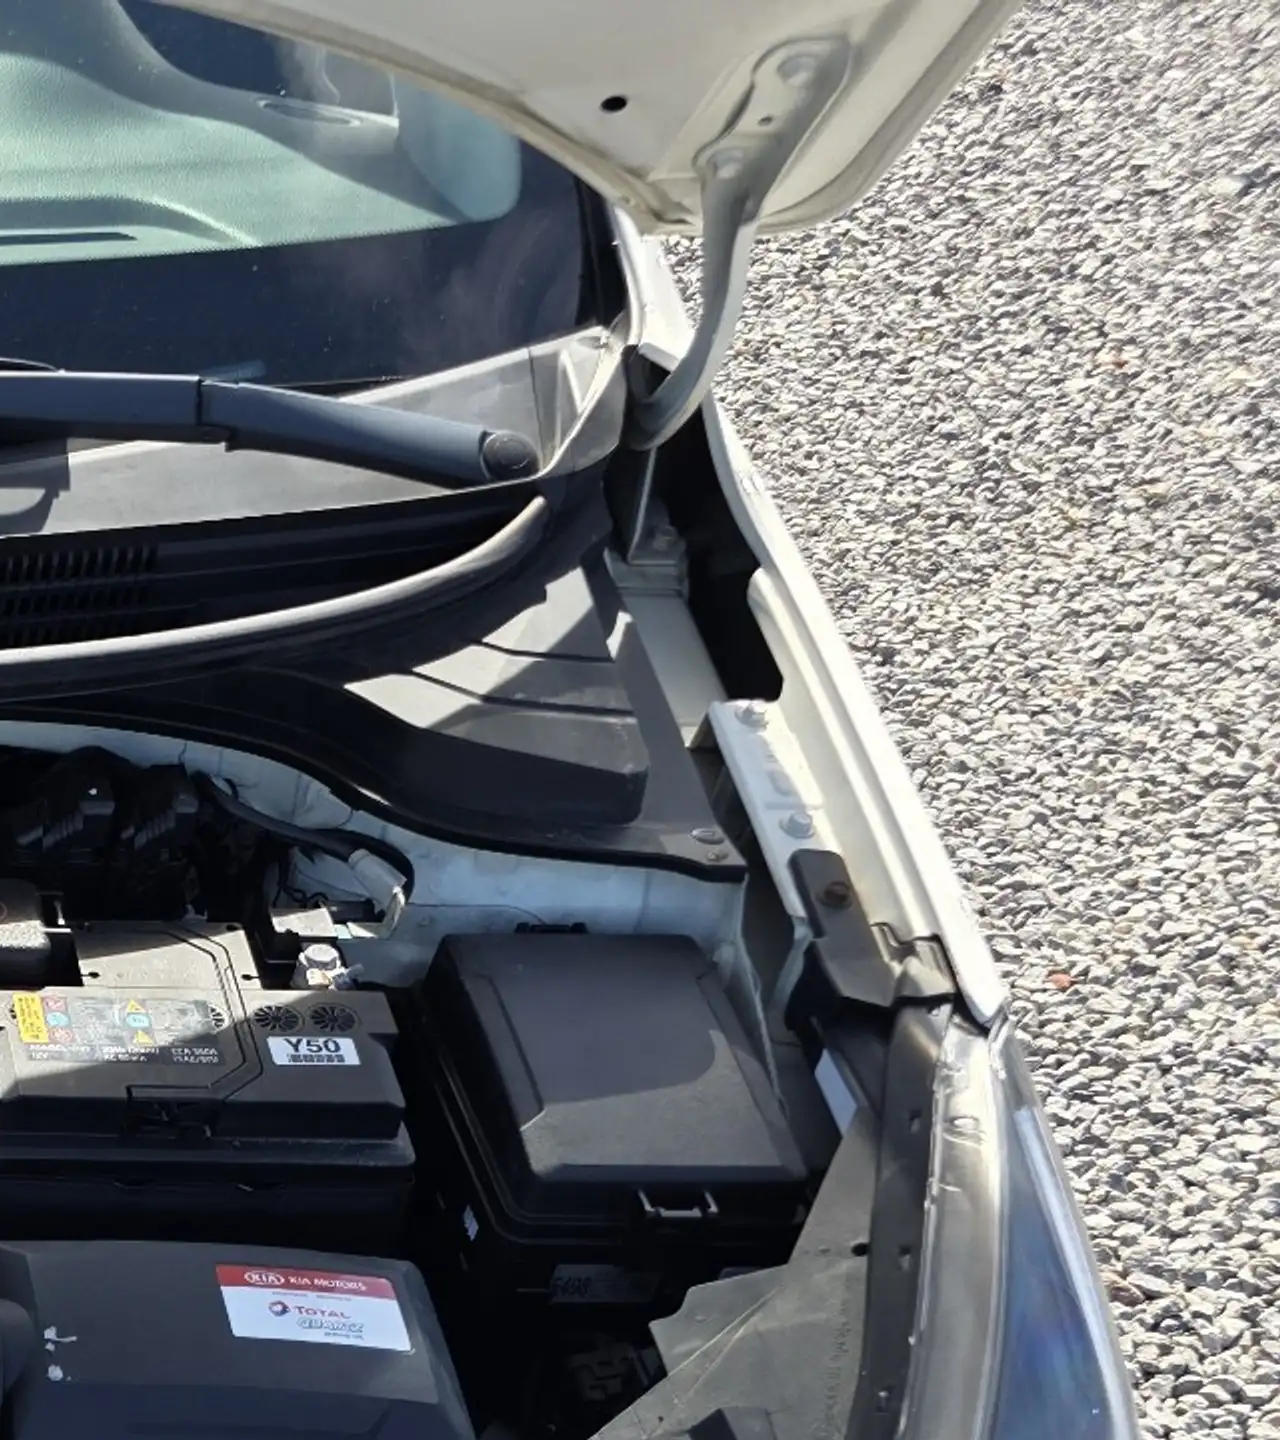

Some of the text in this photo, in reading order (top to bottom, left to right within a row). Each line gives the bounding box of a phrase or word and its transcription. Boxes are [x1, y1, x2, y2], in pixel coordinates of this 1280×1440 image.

[283, 1038, 341, 1053] Y50
[314, 1278, 368, 1292] MOTORS
[295, 1305, 351, 1320] TOTAL
